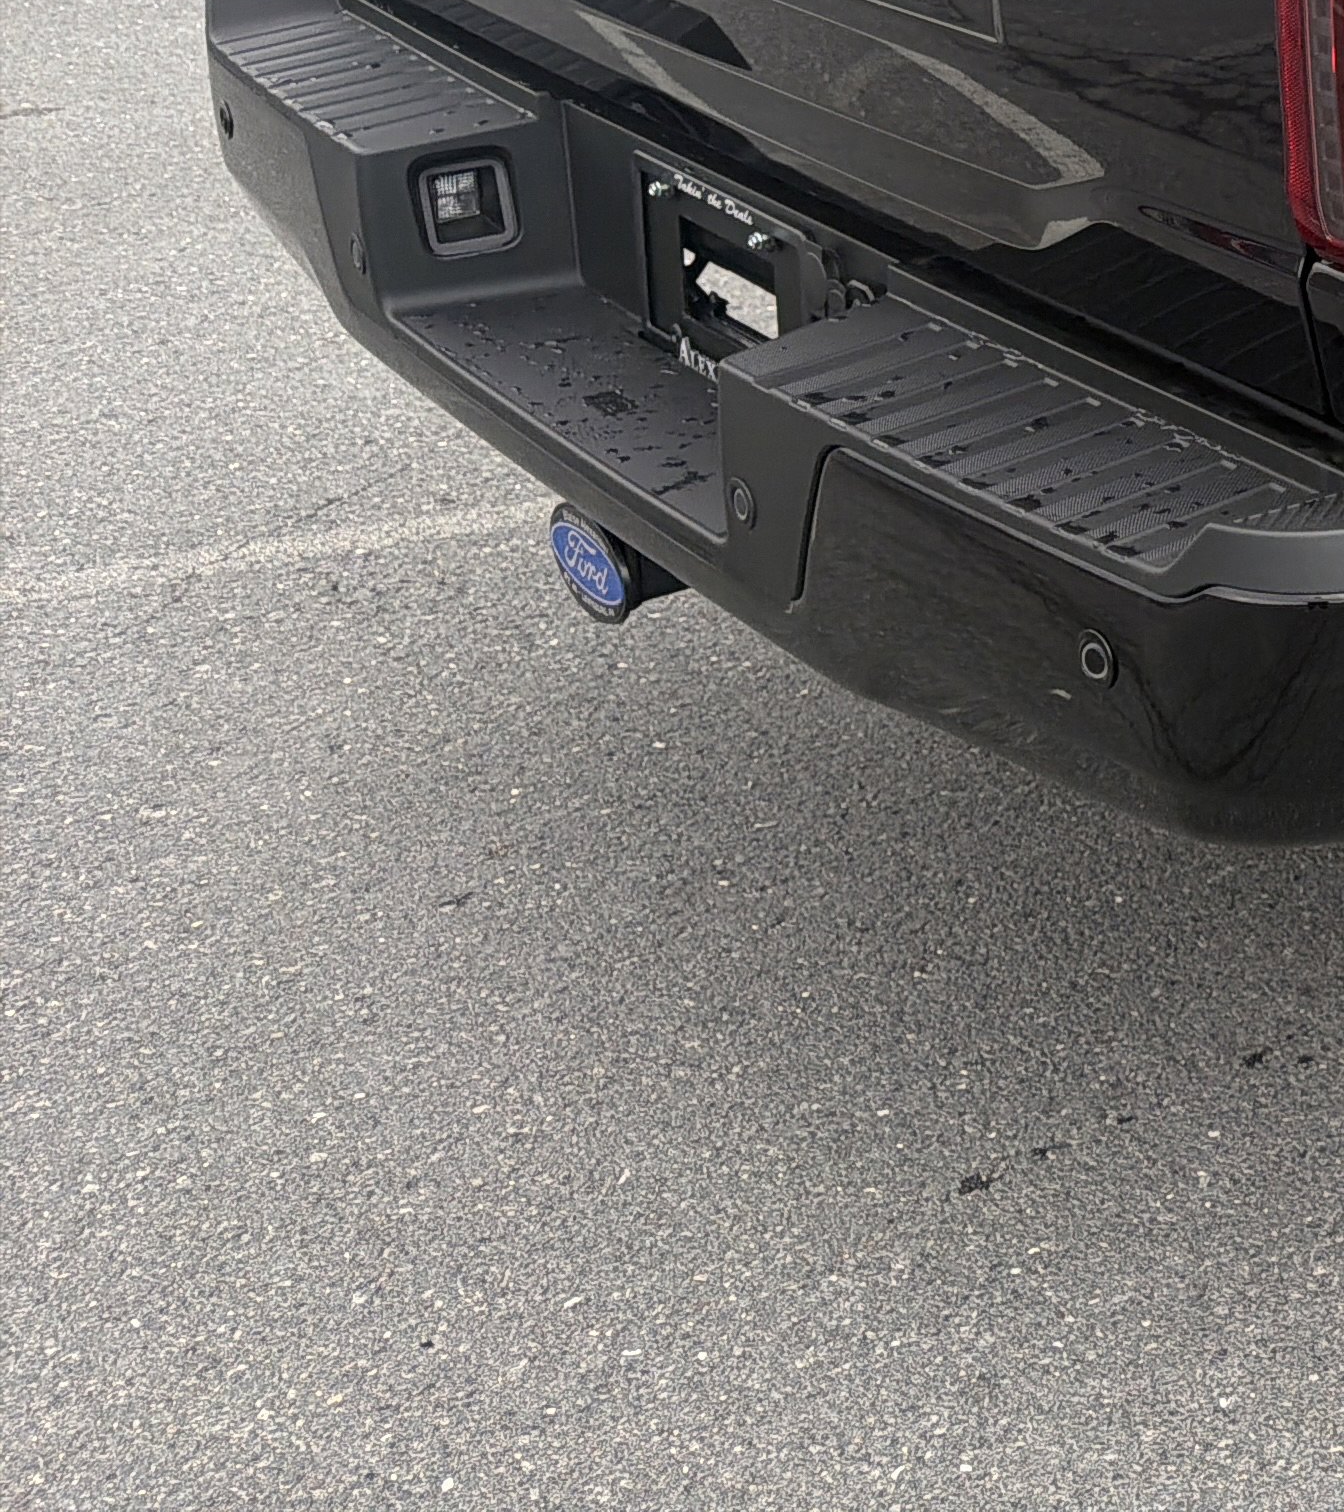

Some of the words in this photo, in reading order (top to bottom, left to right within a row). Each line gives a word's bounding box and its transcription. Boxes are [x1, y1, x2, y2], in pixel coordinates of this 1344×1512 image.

[707, 194, 723, 210] the
[724, 198, 754, 226] Deals
[564, 530, 609, 595] Ford
